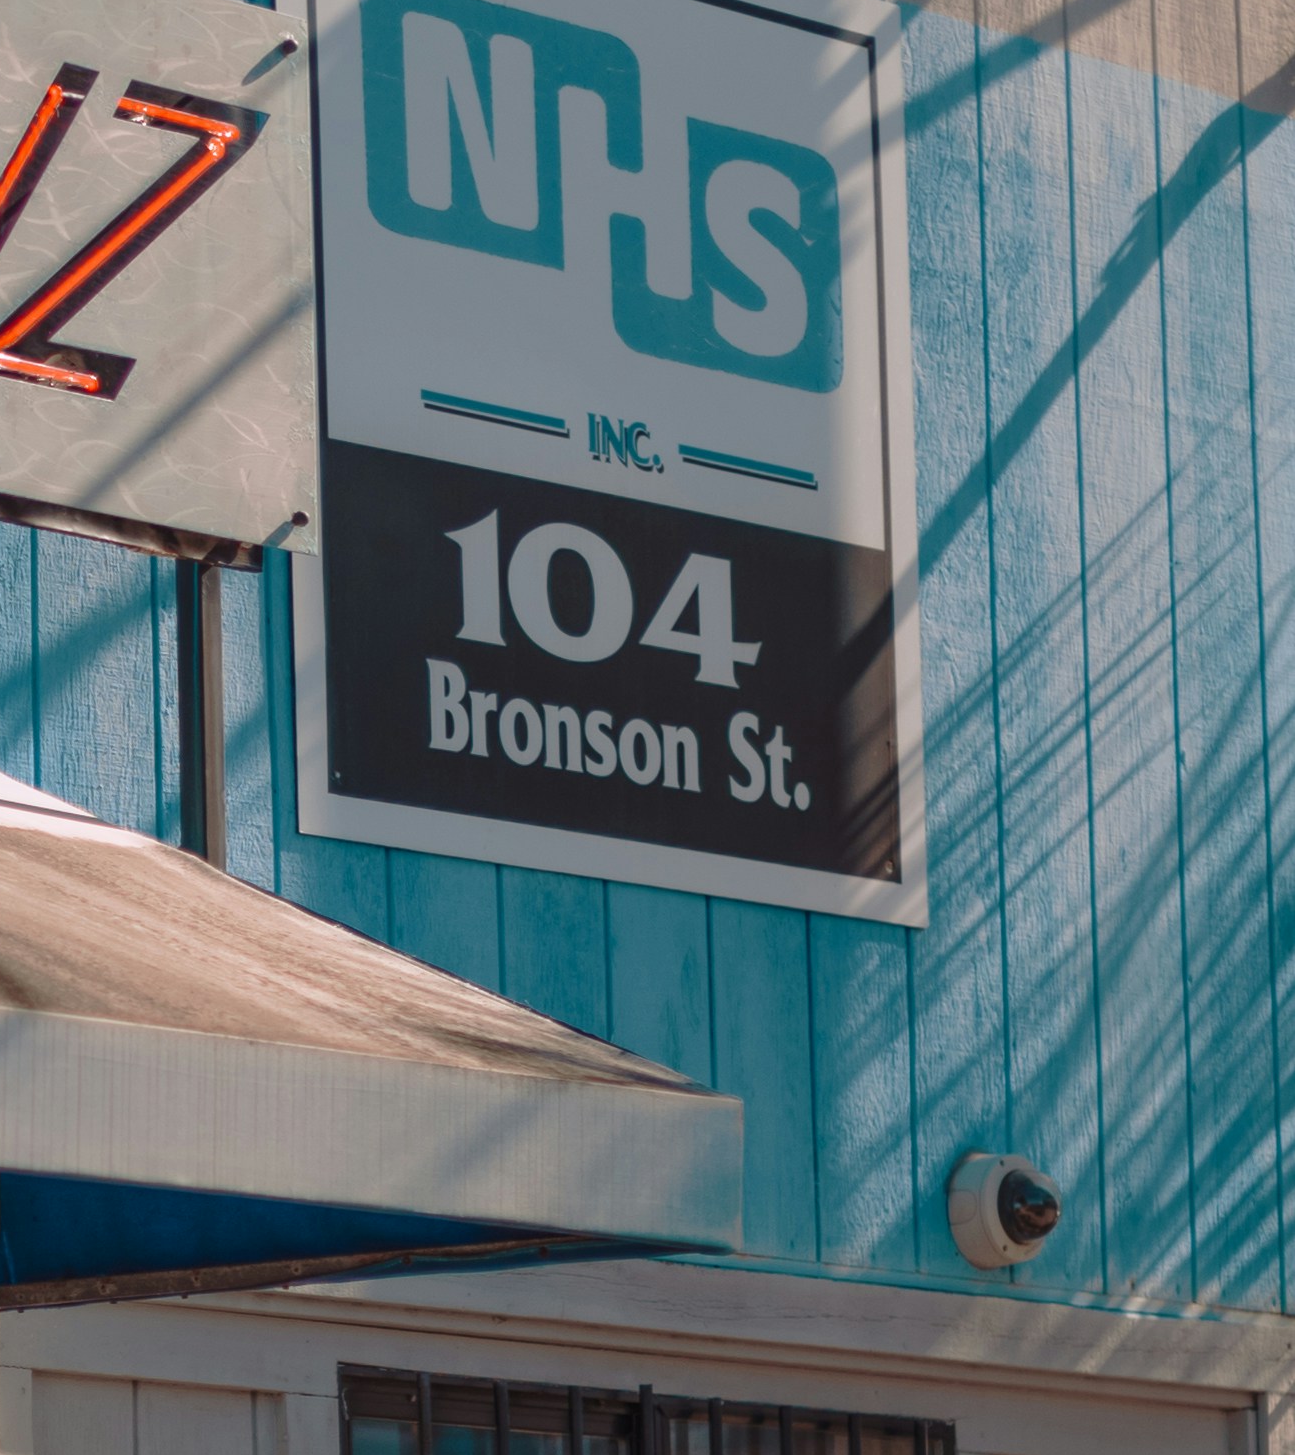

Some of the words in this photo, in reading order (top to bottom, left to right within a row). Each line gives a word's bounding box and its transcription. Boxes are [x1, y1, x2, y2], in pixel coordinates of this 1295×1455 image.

[394, 2, 816, 362] NHS
[586, 410, 665, 474] INC.
[444, 508, 761, 691] 104
[425, 657, 701, 794] Bronson
[726, 709, 811, 813] St.
